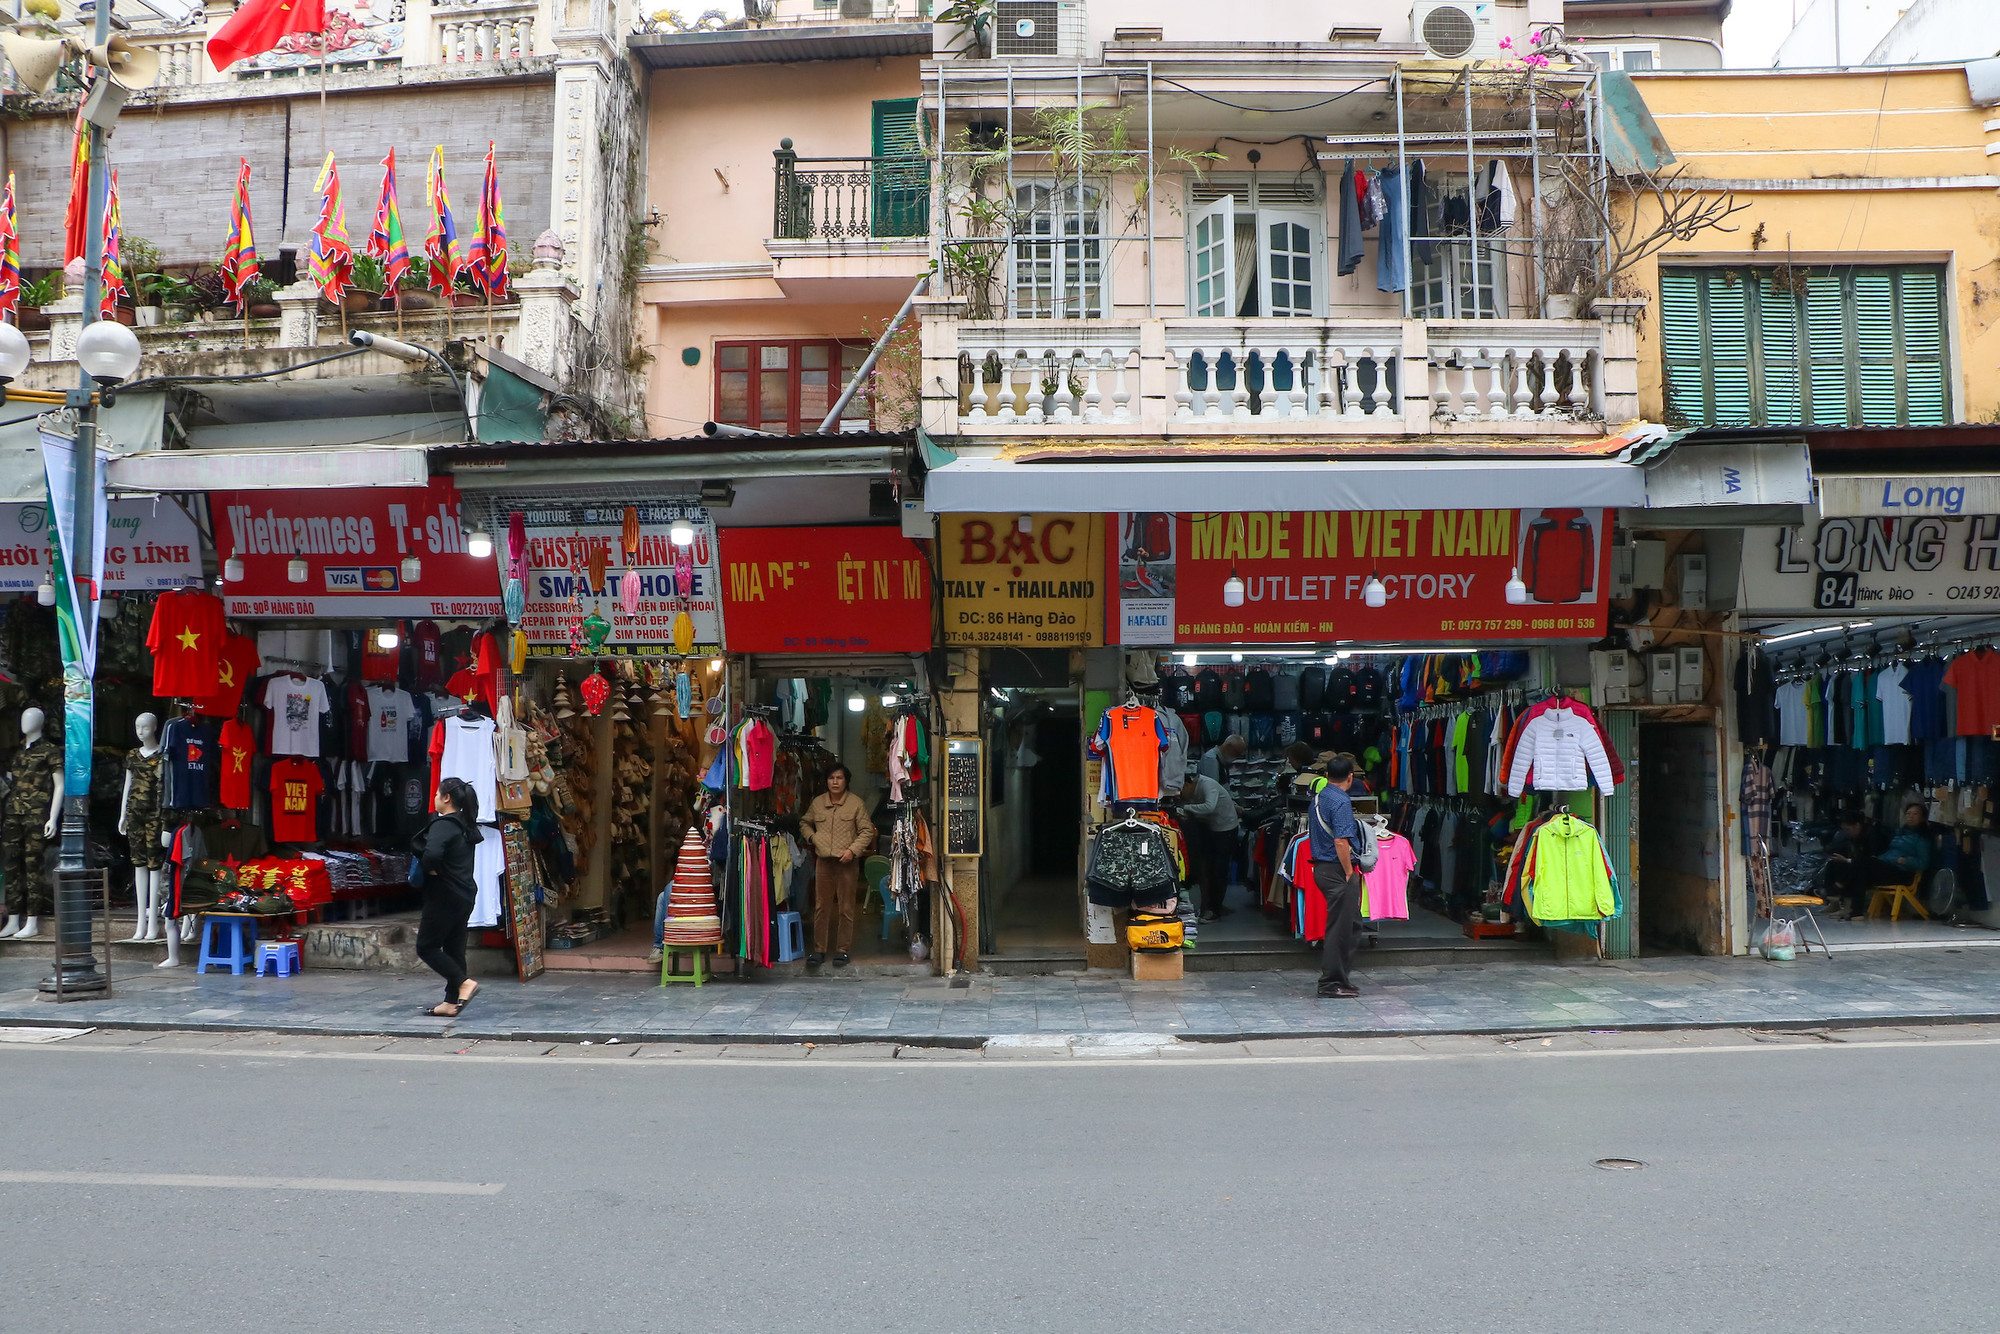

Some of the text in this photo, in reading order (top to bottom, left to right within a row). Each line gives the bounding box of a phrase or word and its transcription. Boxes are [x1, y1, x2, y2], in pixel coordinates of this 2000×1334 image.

[1882, 481, 1965, 513] Long
[527, 511, 571, 522] YOUTUBE
[598, 509, 625, 521] ZALO
[227, 505, 376, 555] Vietnamese
[1191, 509, 1511, 559] MADE IN VIET NAM
[132, 541, 190, 564] LÍNH
[1776, 517, 1948, 573] LONG
[330, 574, 358, 585] VISA
[837, 552, 866, 604] IỆT
[873, 560, 921, 600] NM
[942, 581, 985, 598] ITALY
[1007, 581, 1094, 598] THAILAND
[1247, 575, 1337, 601] UTLET
[1820, 577, 1855, 607] 84
[1857, 587, 1883, 600] HÀNG
[1889, 587, 1914, 600] ĐÀO
[1946, 586, 1980, 600] 0243
[1983, 586, 2000, 600] 92
[232, 602, 252, 614] ADD:
[271, 600, 294, 614] HÀNG
[297, 600, 315, 614] ĐÀO
[430, 602, 449, 615] TEL:
[524, 602, 583, 612] CCESSORS
[521, 616, 555, 626] REPAIR
[650, 615, 669, 627] ĐẸP
[959, 611, 1076, 627] ĐC: 86 Hàng Đào
[1128, 615, 1168, 626] HAFASCO
[1441, 620, 1455, 631] ĐT:
[1458, 620, 1482, 630] 0973
[1485, 619, 1502, 630] 757
[1504, 619, 1522, 630] 299
[1531, 619, 1555, 629] 0968
[1557, 618, 1574, 629] 001
[1577, 618, 1595, 629] 536
[615, 630, 633, 639] SIM
[636, 629, 669, 640] PHONG
[1178, 623, 1190, 635] 86
[1193, 622, 1221, 634] HÀNG
[1224, 622, 1244, 634] ĐÀO
[1253, 621, 1281, 634] HOÀN
[1284, 619, 1309, 633] KIẾM
[1319, 622, 1333, 633] HN
[543, 630, 567, 640] FREE
